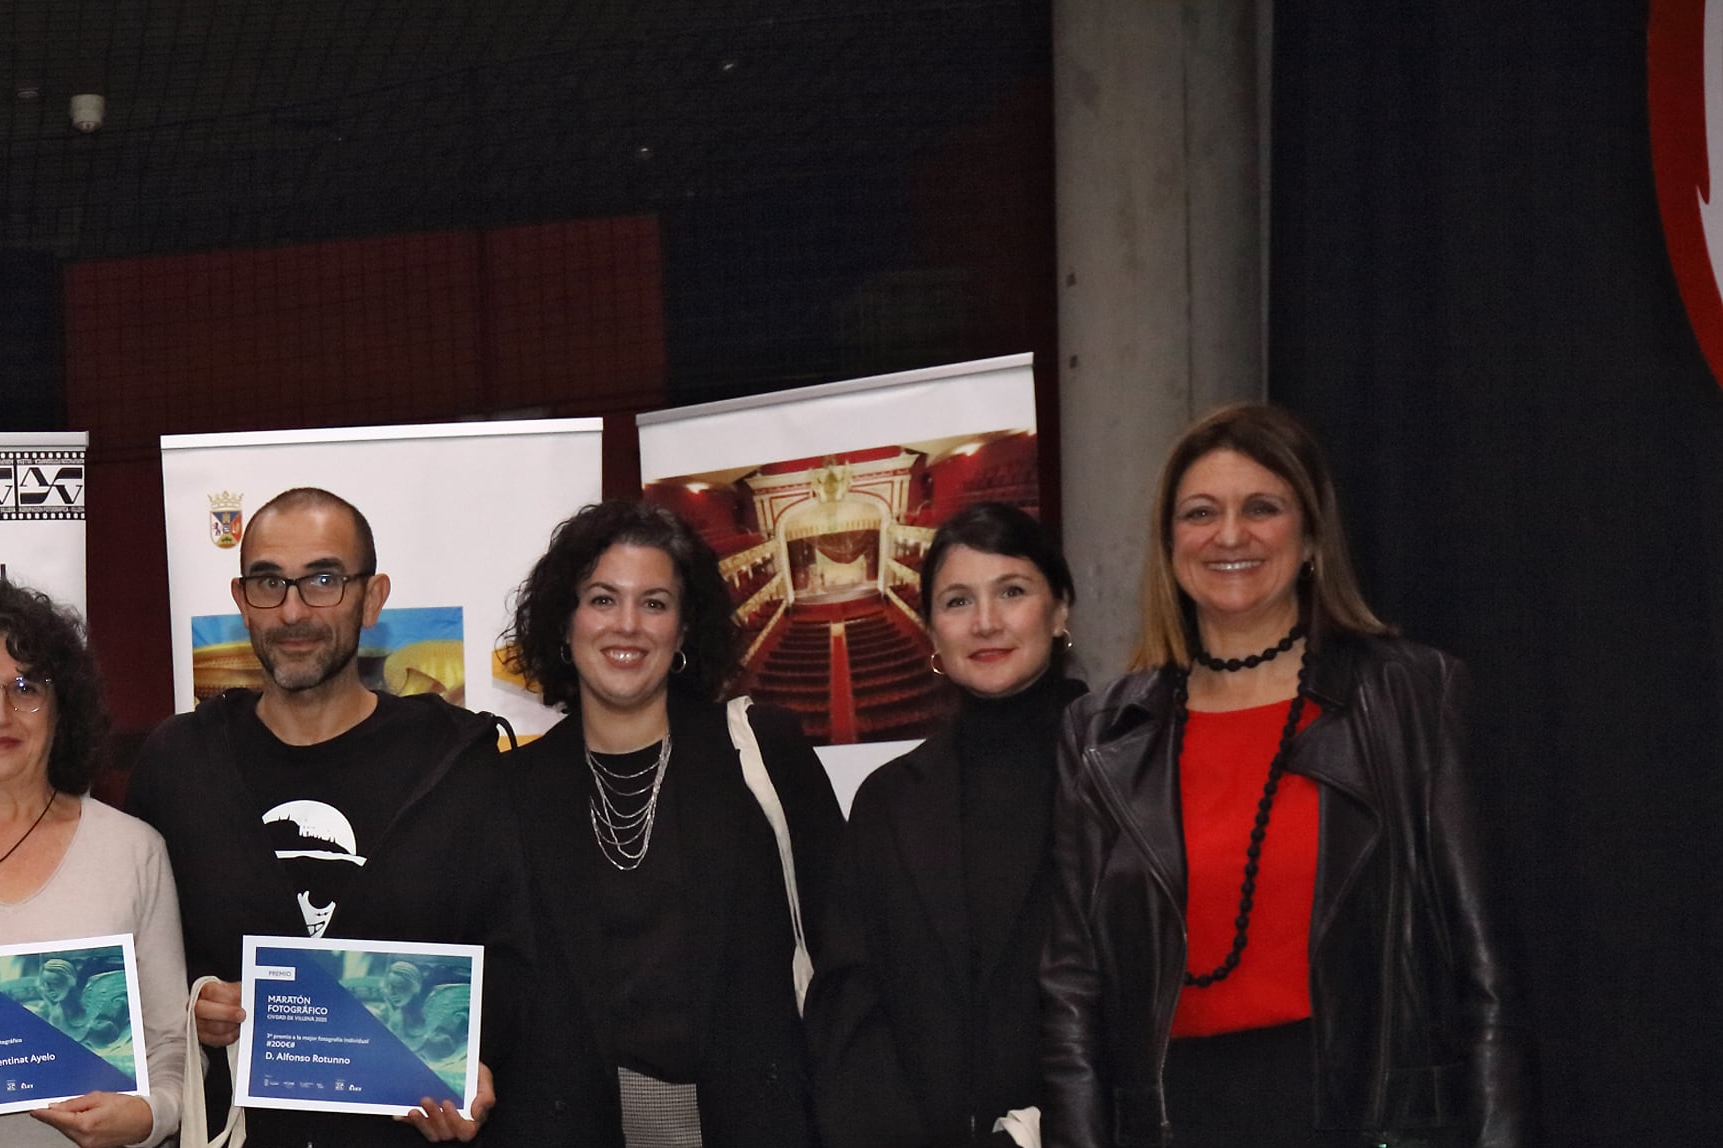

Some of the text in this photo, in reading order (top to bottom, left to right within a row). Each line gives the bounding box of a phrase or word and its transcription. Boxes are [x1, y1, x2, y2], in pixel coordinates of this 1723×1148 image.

[268, 995, 311, 1005] MARATÓN
[268, 1004, 328, 1015] FOTOGRÁFICO
[30, 1052, 55, 1064] Ayelo
[265, 1051, 351, 1065] D. Alfonso Rotunno
